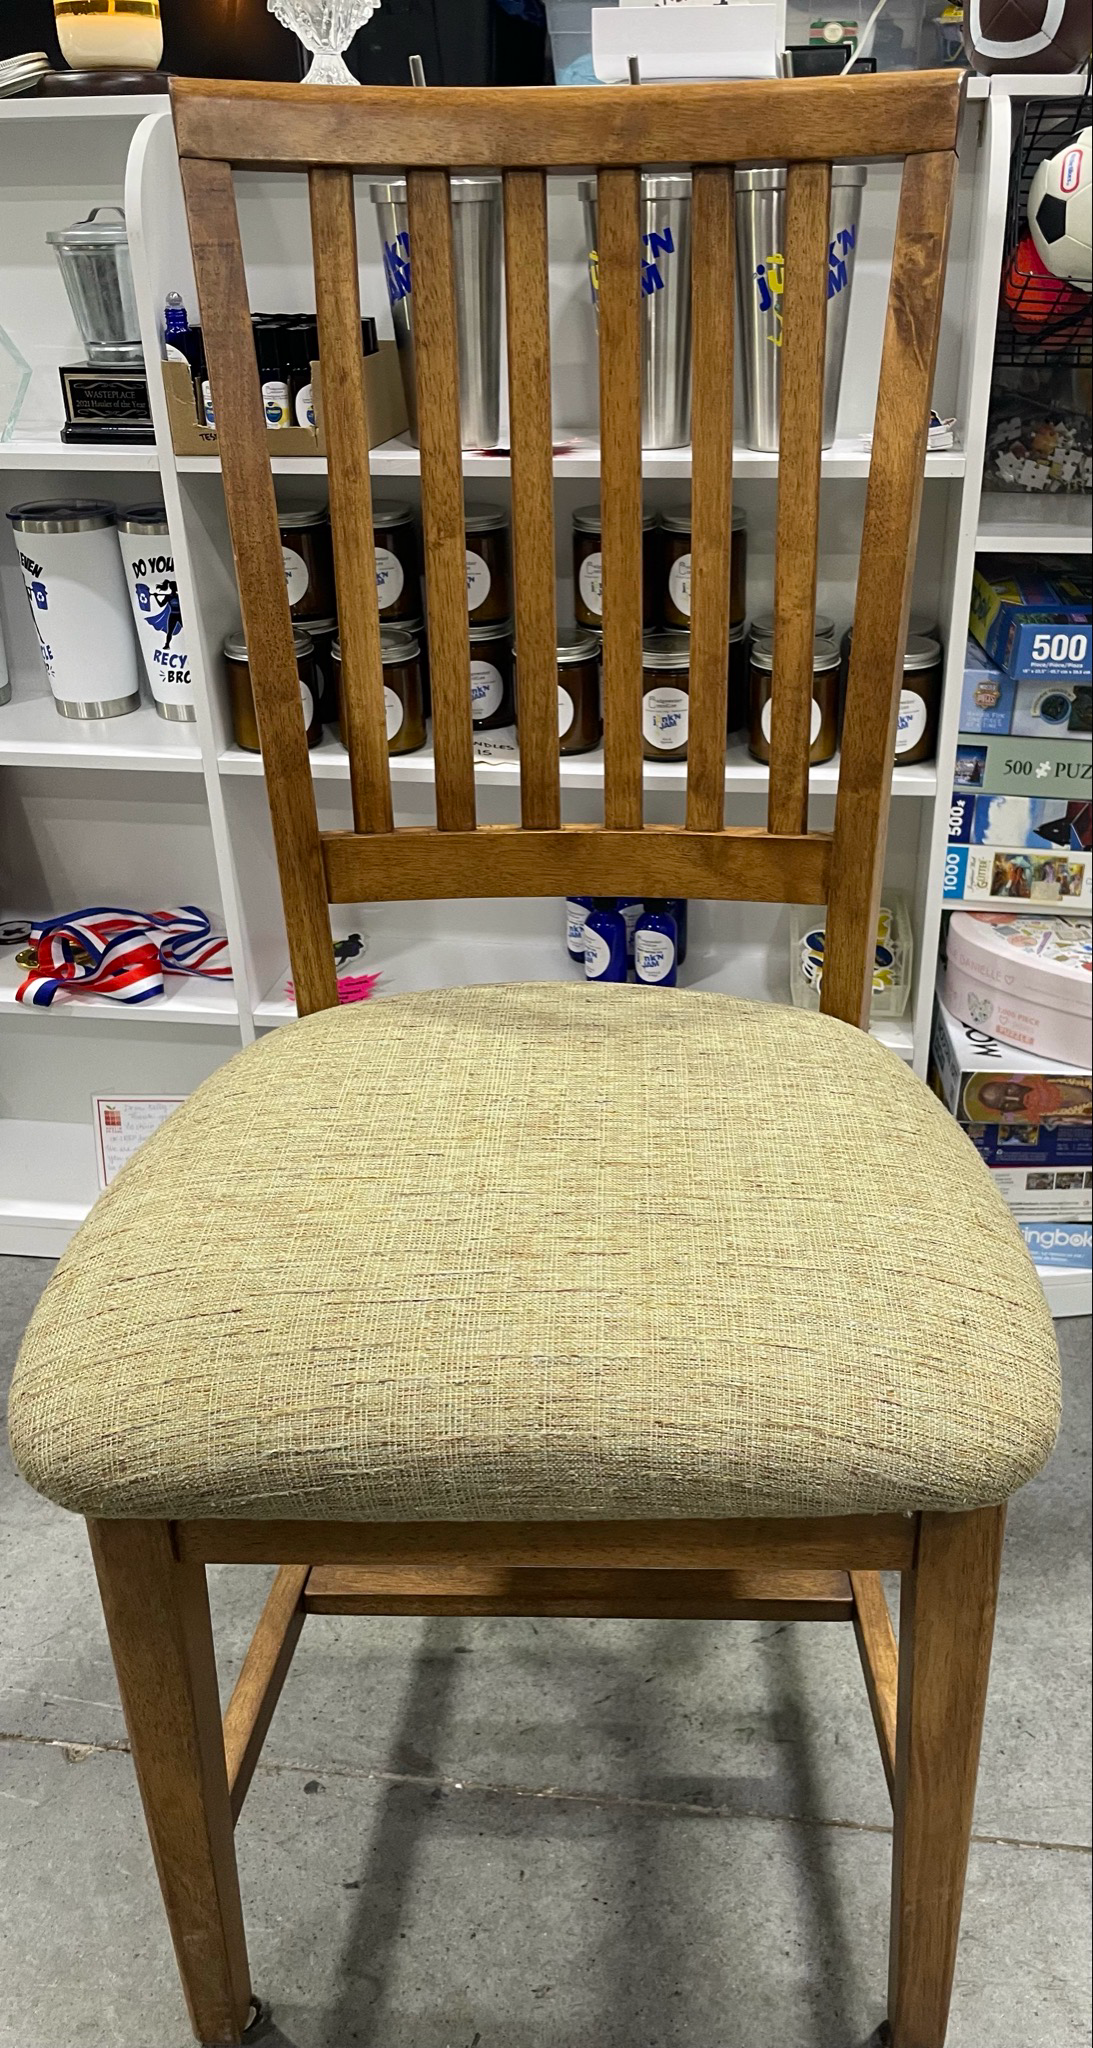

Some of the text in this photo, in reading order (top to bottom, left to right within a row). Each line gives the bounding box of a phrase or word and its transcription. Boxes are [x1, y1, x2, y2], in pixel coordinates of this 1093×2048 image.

[76, 400, 90, 408] 2021
[113, 400, 119, 408] of
[121, 400, 130, 408] the
[131, 401, 146, 409] Year
[84, 390, 136, 399] WASTEPLACE
[132, 556, 174, 579] DO YOU
[1031, 634, 1088, 661] 500
[1003, 759, 1033, 776] 500
[948, 806, 964, 836] 500
[943, 853, 960, 891] 1000
[959, 957, 1002, 982] DANIELLE
[1022, 1226, 1092, 1250] ingbok
